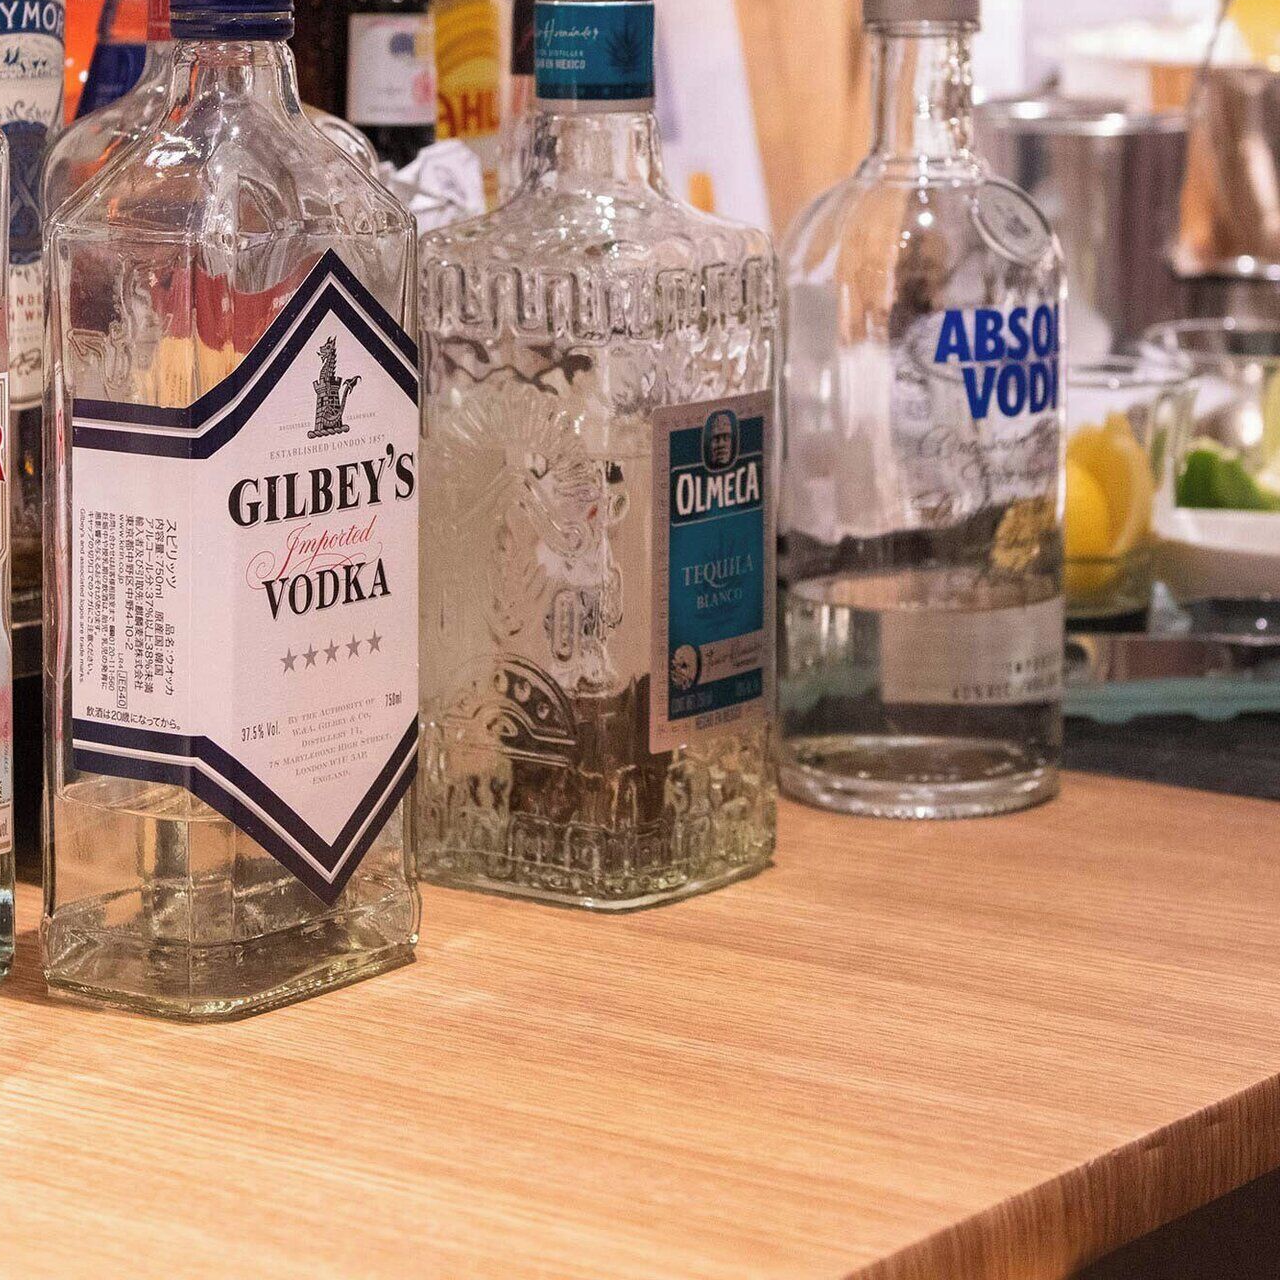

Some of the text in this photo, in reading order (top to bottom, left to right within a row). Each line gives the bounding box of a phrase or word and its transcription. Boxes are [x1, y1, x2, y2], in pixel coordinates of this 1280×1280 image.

[269, 441, 330, 461] ESTABLISHED
[332, 436, 366, 450] LONDON
[227, 442, 416, 528] GILBEY'S
[676, 461, 760, 517] OLMECA
[166, 518, 178, 589] スピリッツ
[276, 514, 379, 580] Imported
[681, 554, 754, 590] TEQUILA
[261, 557, 392, 621] VODKA
[696, 588, 743, 611] BLANCO
[319, 701, 364, 716] AUTHORITY
[365, 697, 376, 706] OF
[384, 690, 403, 708] 750ml
[85, 705, 182, 732] 飲酒は20歳になってから。
[241, 720, 281, 743] 37.5% Vol.
[301, 731, 347, 748] DISTILLERY
[282, 747, 336, 767] MARYLEBONE
[337, 741, 358, 752] HIGH
[295, 763, 328, 777] LONDON
